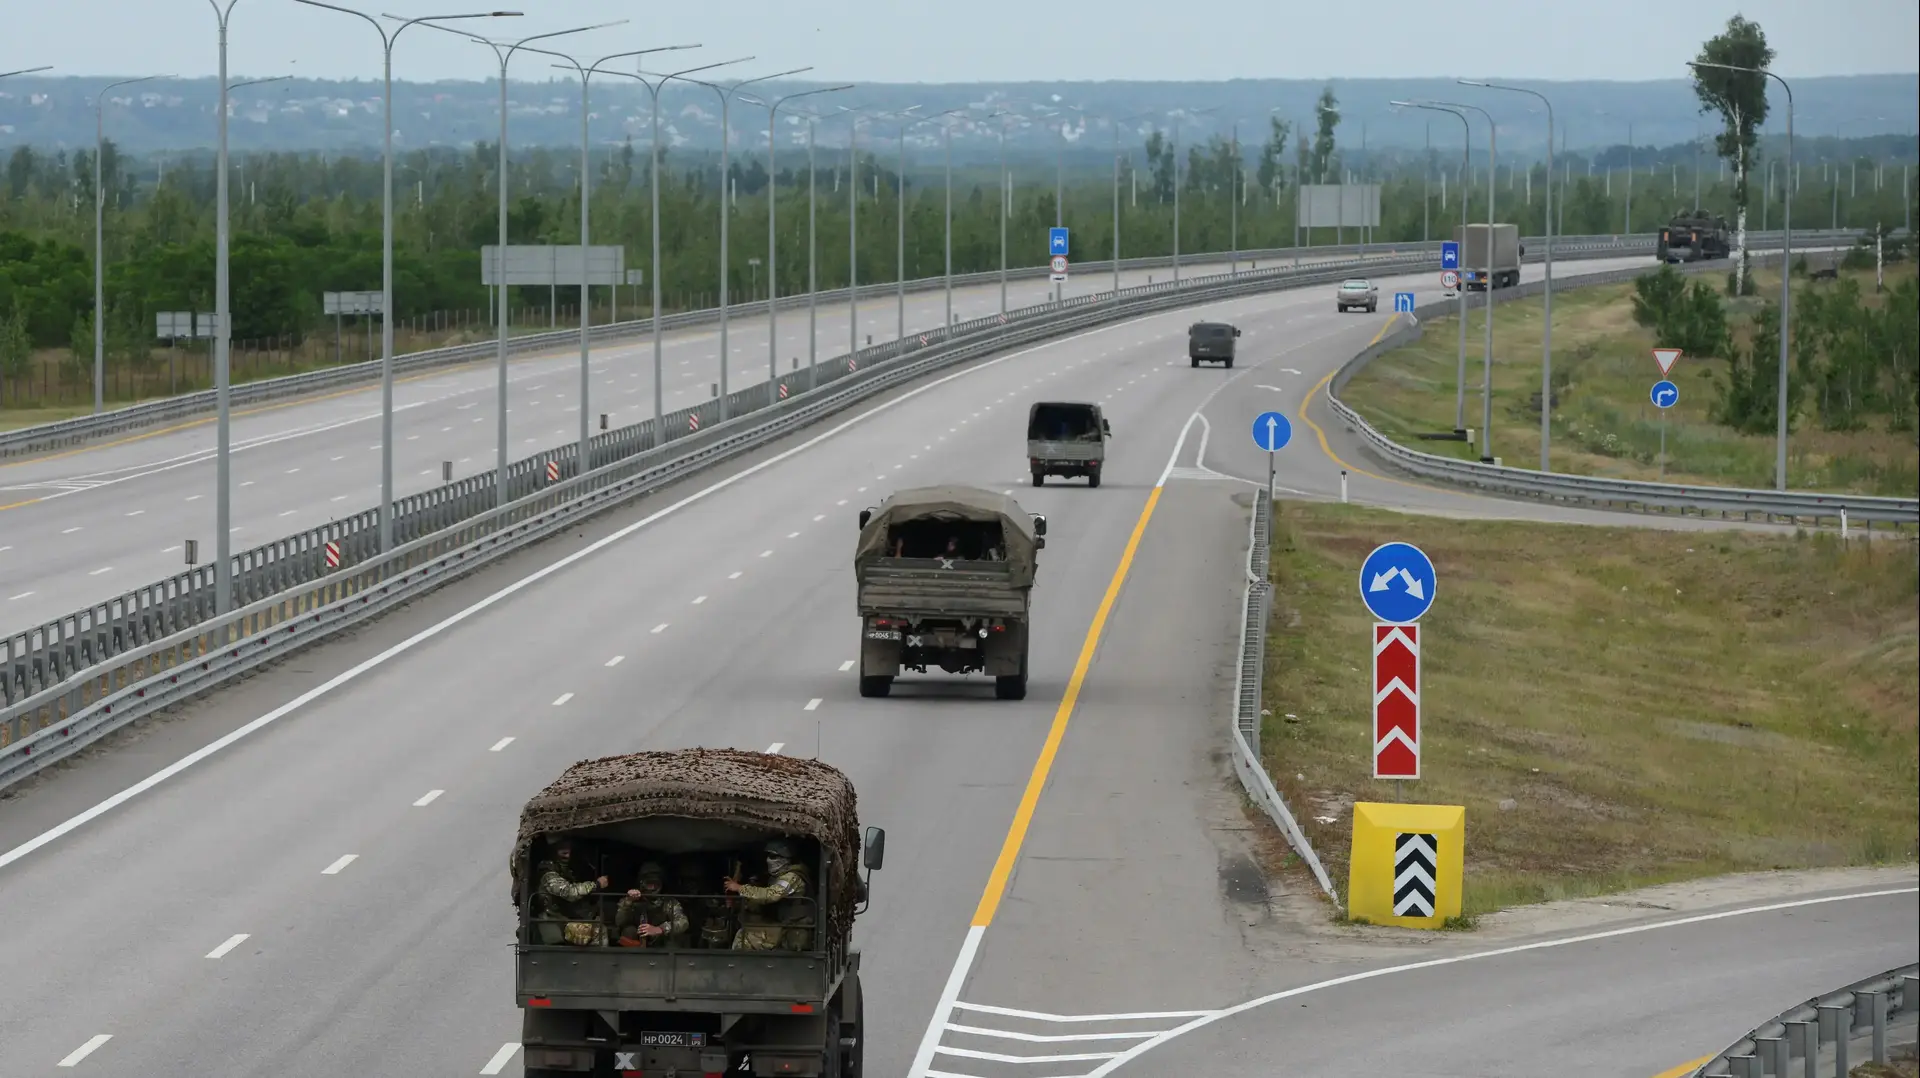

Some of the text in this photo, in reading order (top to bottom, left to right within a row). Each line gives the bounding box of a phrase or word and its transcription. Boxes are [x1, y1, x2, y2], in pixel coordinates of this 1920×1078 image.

[1053, 260, 1065, 268] 110
[940, 559, 954, 570] X
[908, 635, 923, 648] X
[614, 1052, 636, 1070] X
